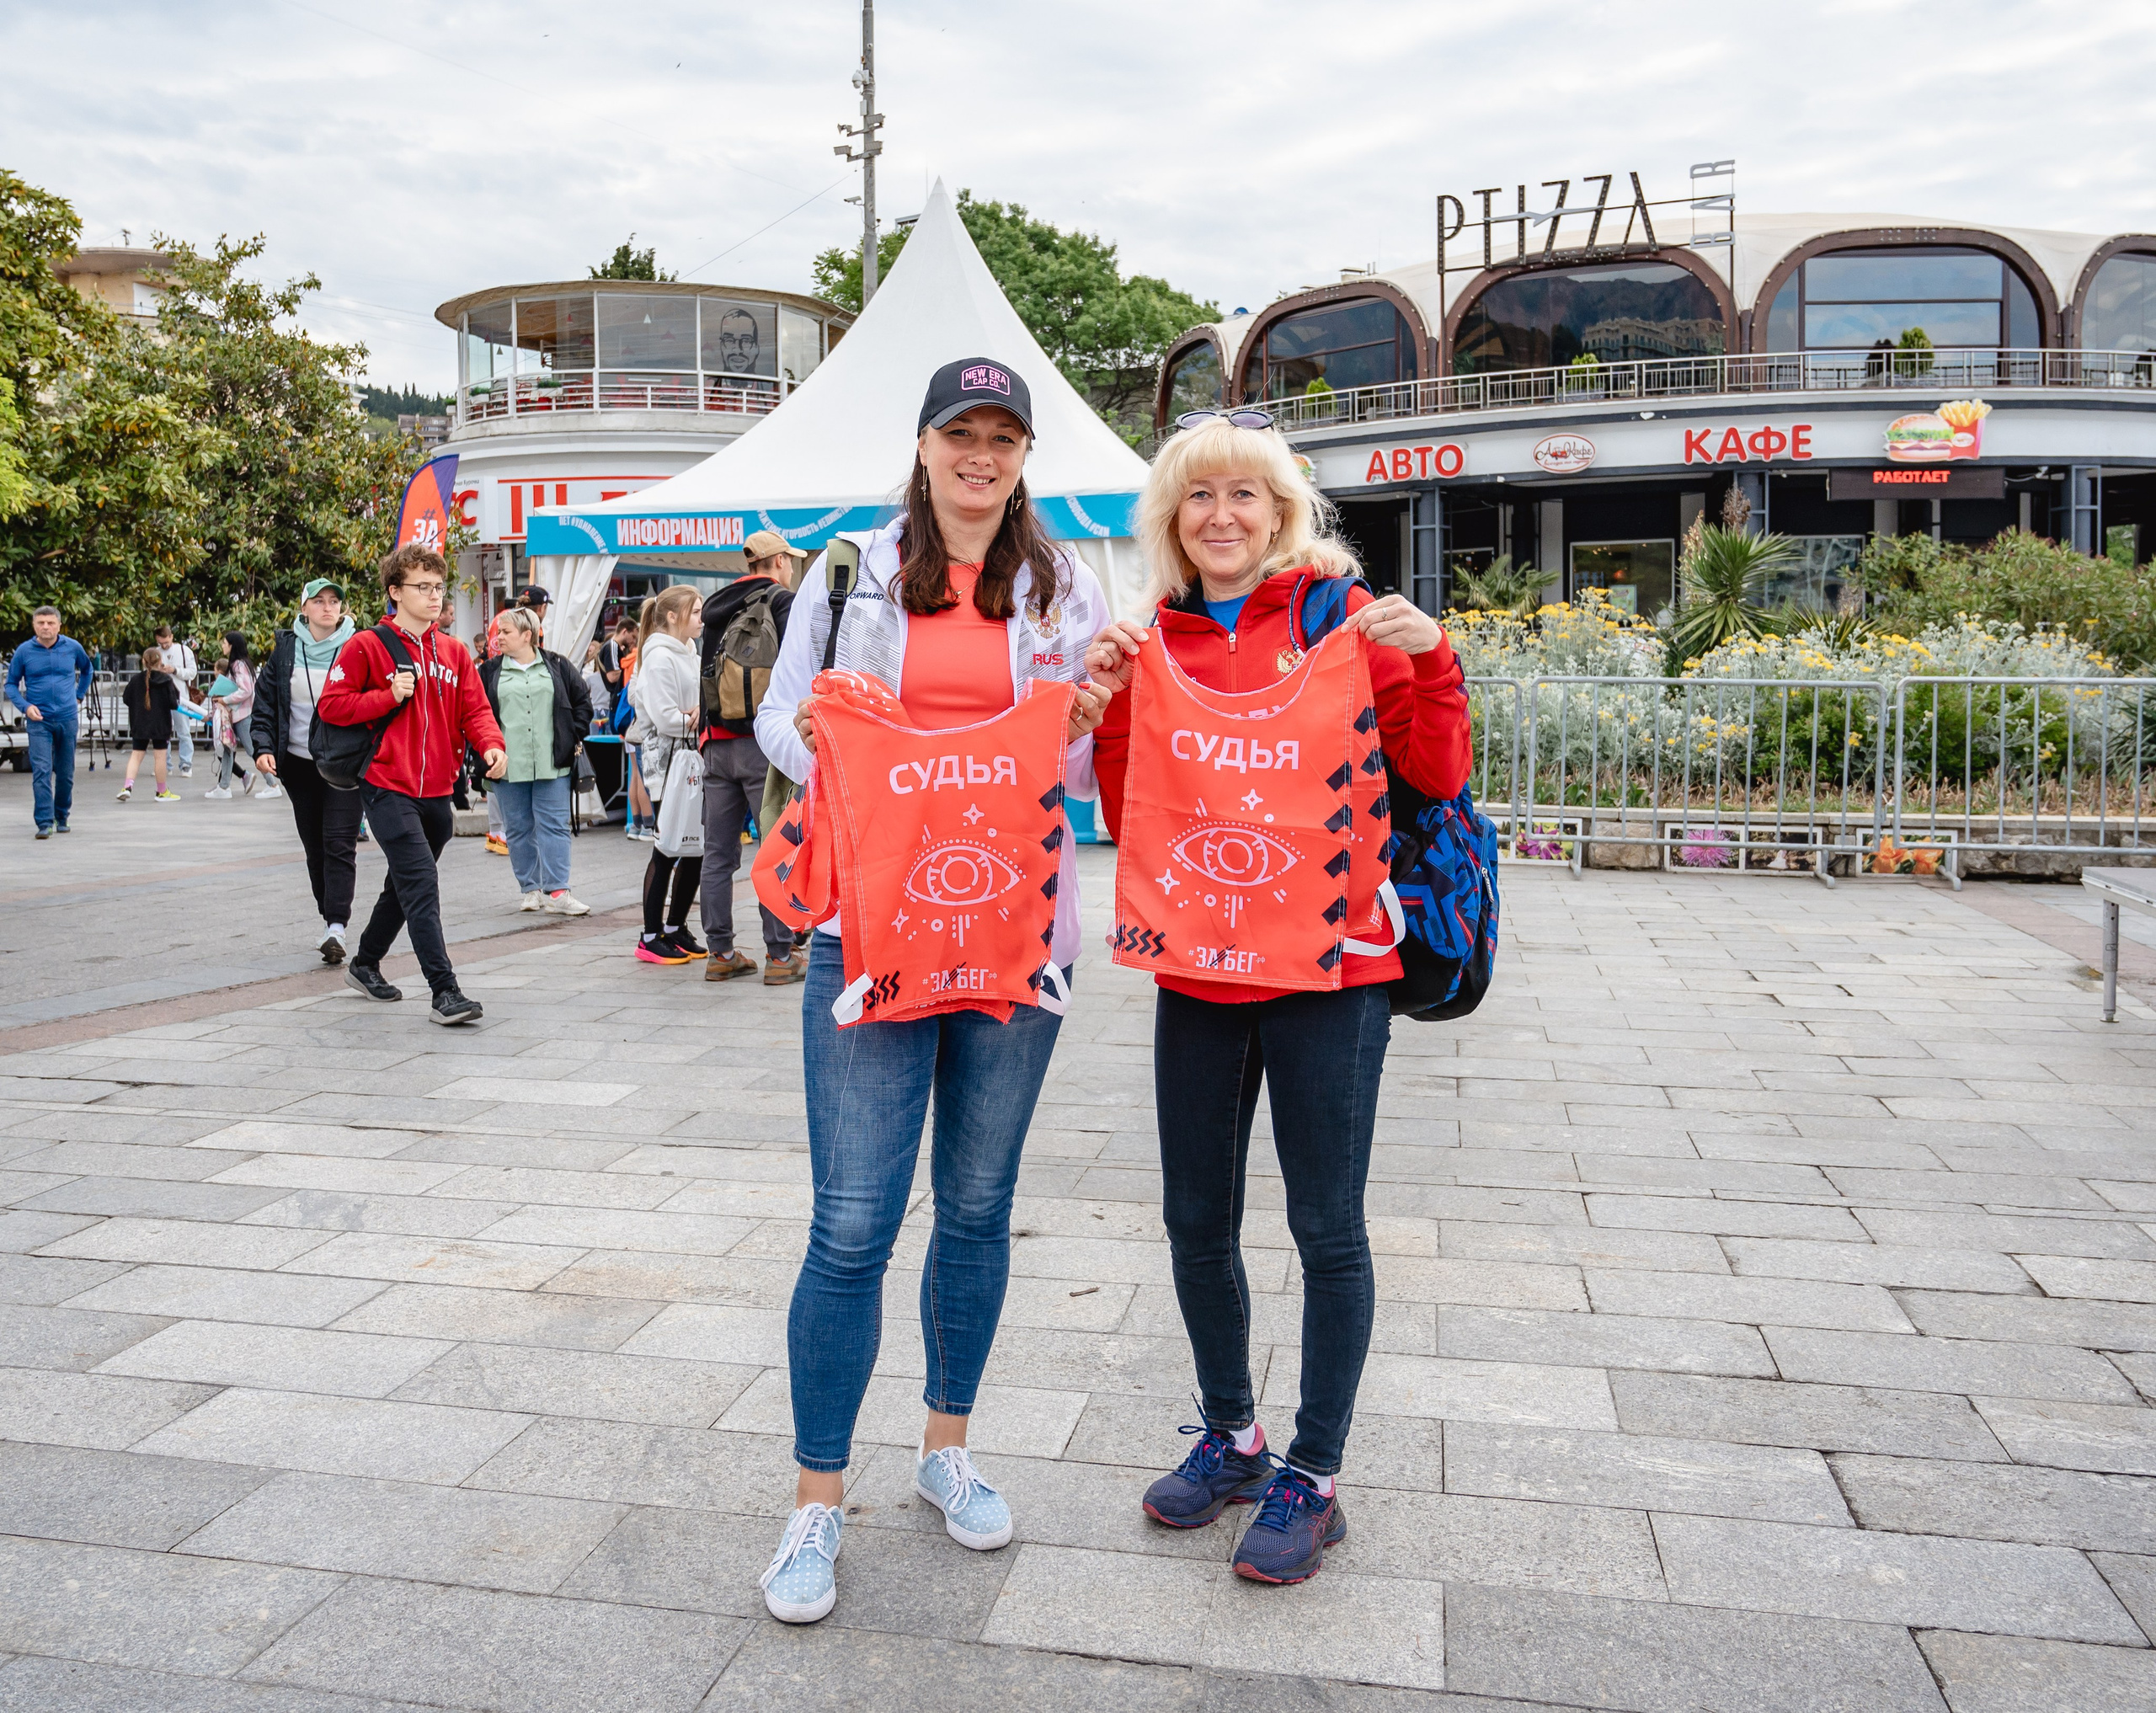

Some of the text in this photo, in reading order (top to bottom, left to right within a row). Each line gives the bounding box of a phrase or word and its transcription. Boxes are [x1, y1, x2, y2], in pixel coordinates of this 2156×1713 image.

[965, 368, 1006, 385] NEW ERA
[989, 379, 1001, 388] CO.
[1684, 424, 1812, 463] КАФЕ
[1365, 444, 1465, 483] АВТО
[1873, 470, 1951, 483] РАБОТАЕТ
[616, 517, 744, 549] ИНФОРМАЦИЯ
[849, 591, 884, 600] ORWARD
[1033, 654, 1064, 665] RUS
[1170, 729, 1299, 774] СУДЬЯ
[889, 755, 1017, 795] СУДЬЯ
